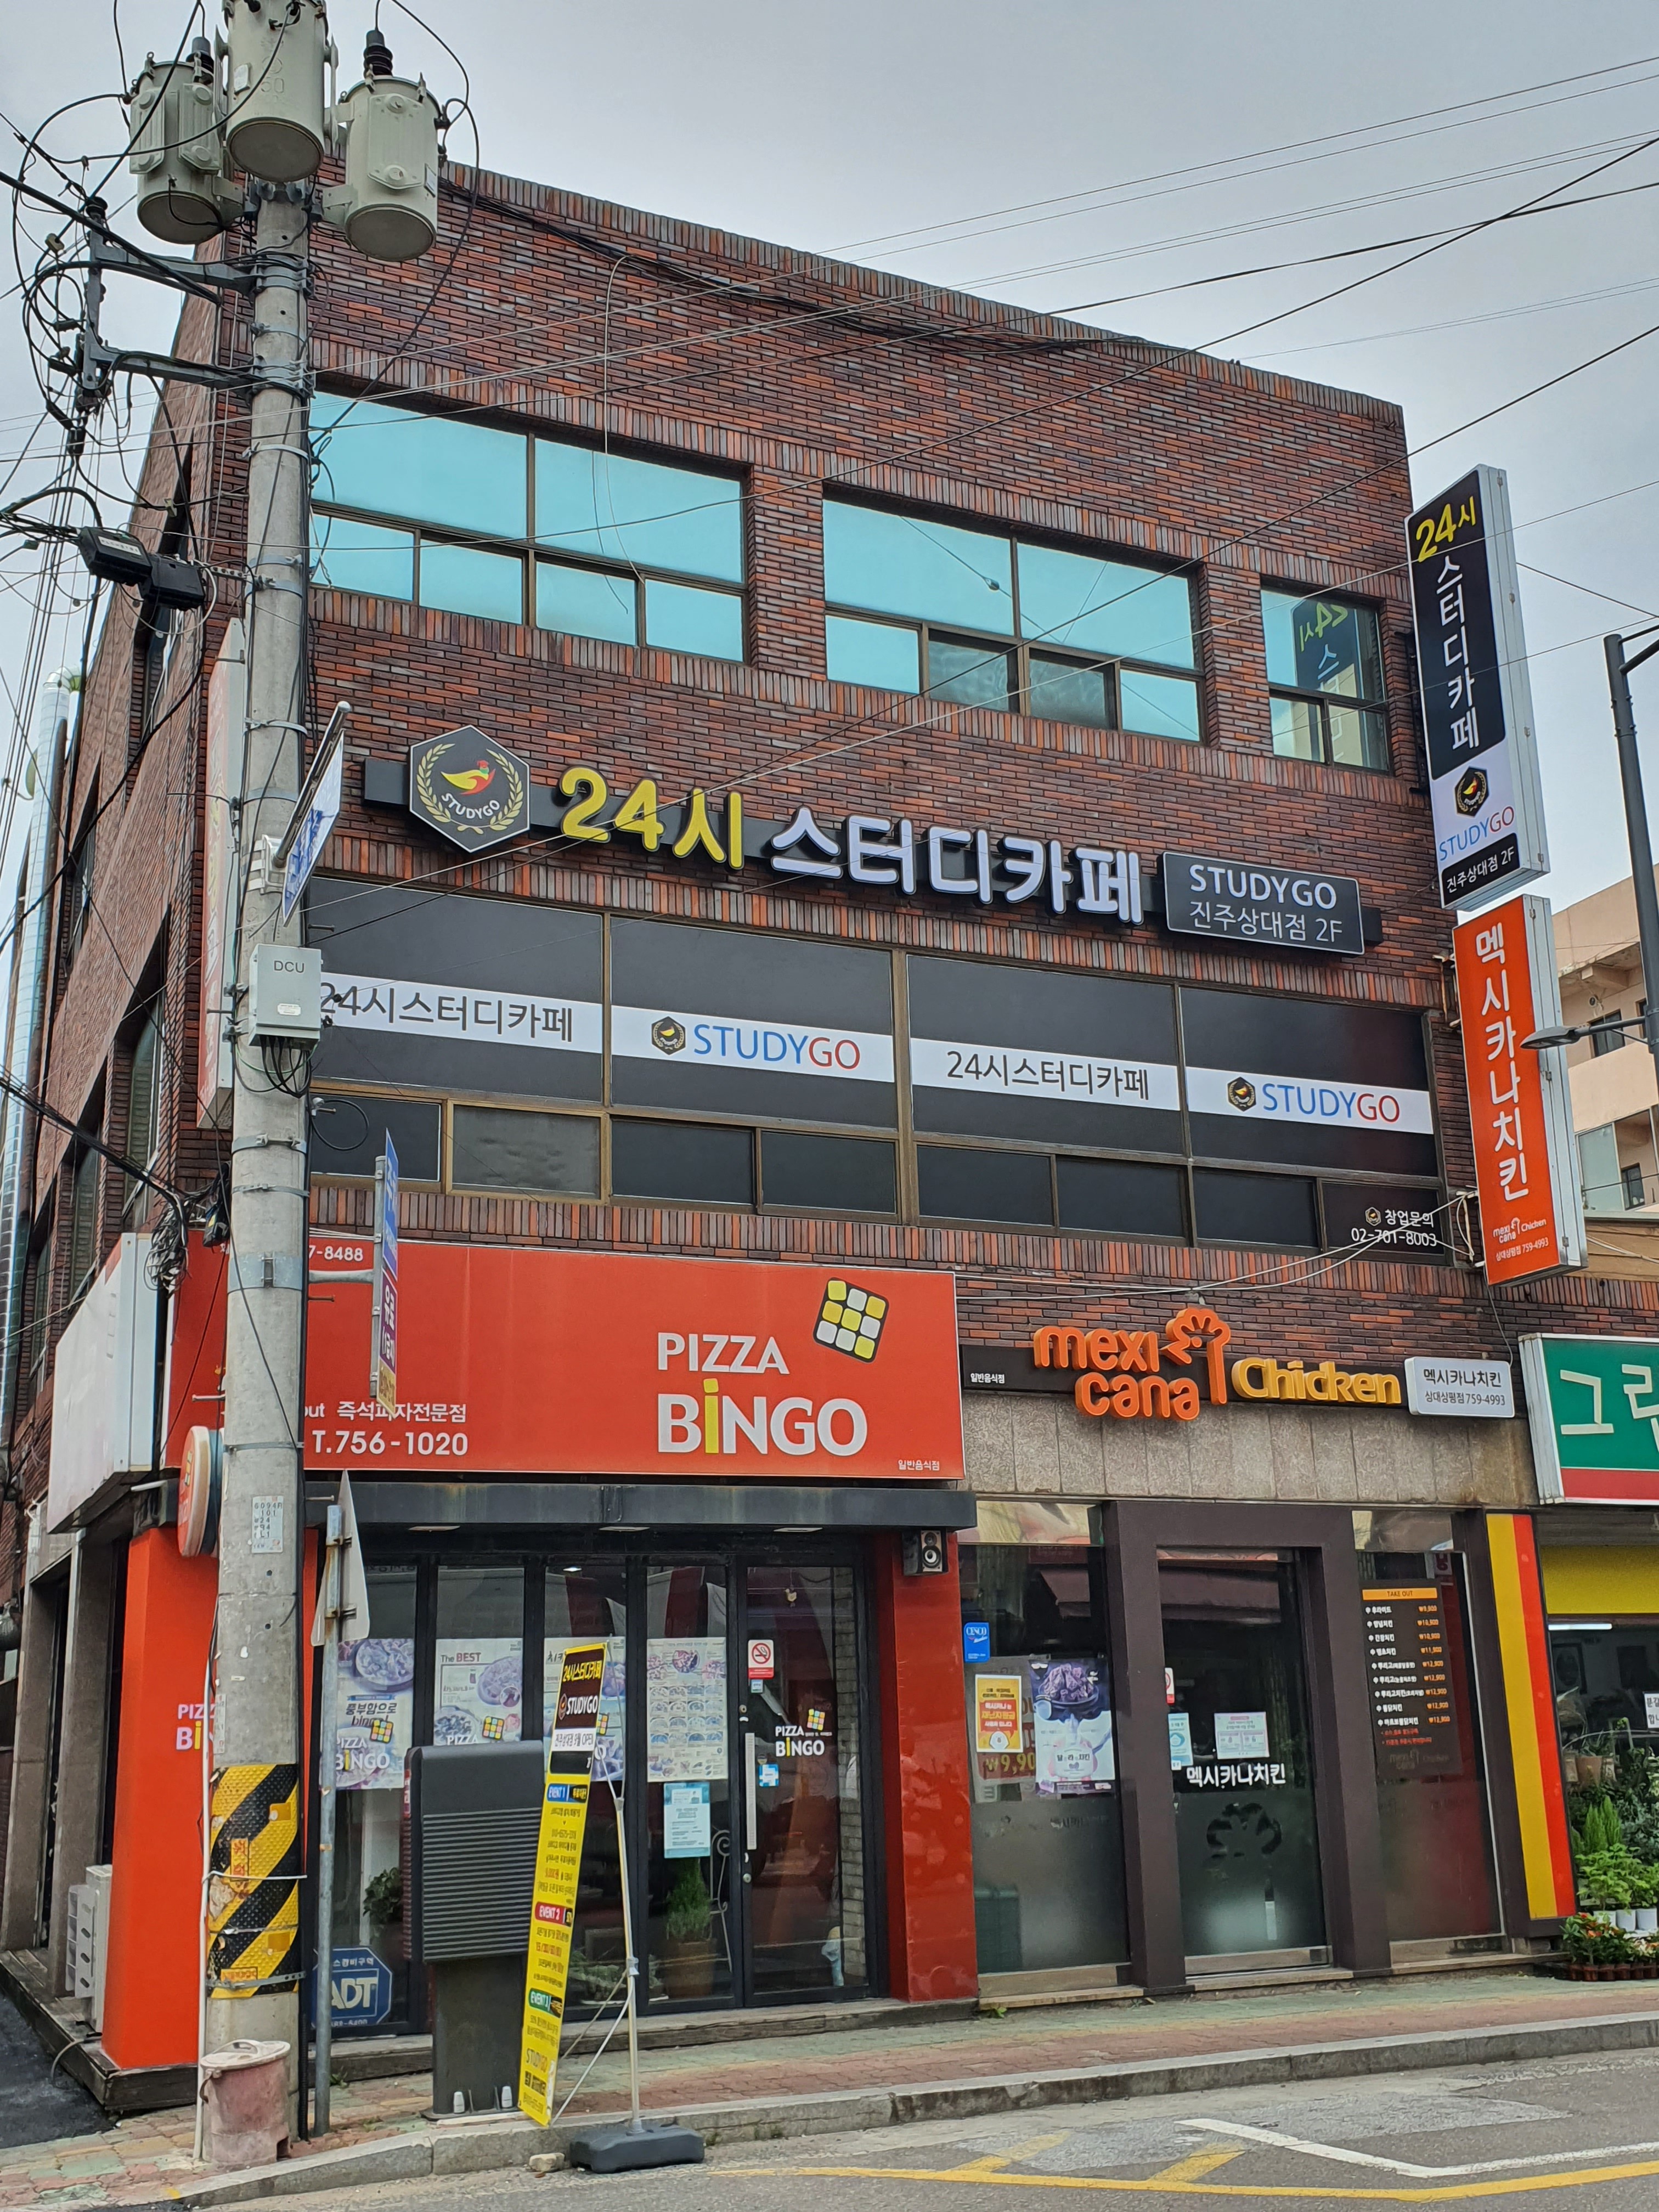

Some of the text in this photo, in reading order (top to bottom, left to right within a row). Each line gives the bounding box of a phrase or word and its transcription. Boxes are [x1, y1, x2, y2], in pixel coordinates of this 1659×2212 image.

[1416, 495, 1476, 562] 24시
[1436, 556, 1480, 750] 스터디카페
[441, 793, 500, 820] STUDYGO
[558, 766, 1144, 926] 24시 스터디카페
[1438, 806, 1515, 862] STUDYGO
[1446, 845, 1515, 894] 진주상대점 2F
[1189, 864, 1338, 910] STUDYGO
[1189, 907, 1343, 943] 진주상대점 2F
[274, 960, 305, 974] DCU
[320, 982, 573, 1042] 24시스터디카페
[693, 1024, 861, 1070] STUDYGO
[1475, 922, 1530, 1202] 멕시카나치킨
[947, 1050, 1149, 1101] 24시스터디카페
[1262, 1083, 1401, 1124] STUDYGO
[1385, 1209, 1434, 1228] 창업문의
[1351, 1228, 1437, 1247] 02-701-8003
[308, 1245, 364, 1262] 7-8488
[658, 1331, 791, 1375] PIZZA
[1032, 1325, 1160, 1374] mexi
[970, 1373, 1005, 1384] 일반음식점
[1231, 1356, 1404, 1405] Chicken
[1423, 1368, 1502, 1387] 멕시카나치킨
[1075, 1373, 1200, 1421] cana
[1465, 1393, 1506, 1406] 759-4993
[312, 1430, 469, 1457] T.756-1020
[898, 1459, 940, 1471] 일반음식점
[441, 1652, 482, 1663] The BEST
[566, 1695, 599, 1716] STUDYGO
[447, 1735, 479, 1746] PIZZA
[775, 1725, 805, 1737] PIZZA
[1186, 1763, 1286, 1788] 멕시카나치킨
[539, 1905, 555, 1919] EVENT
